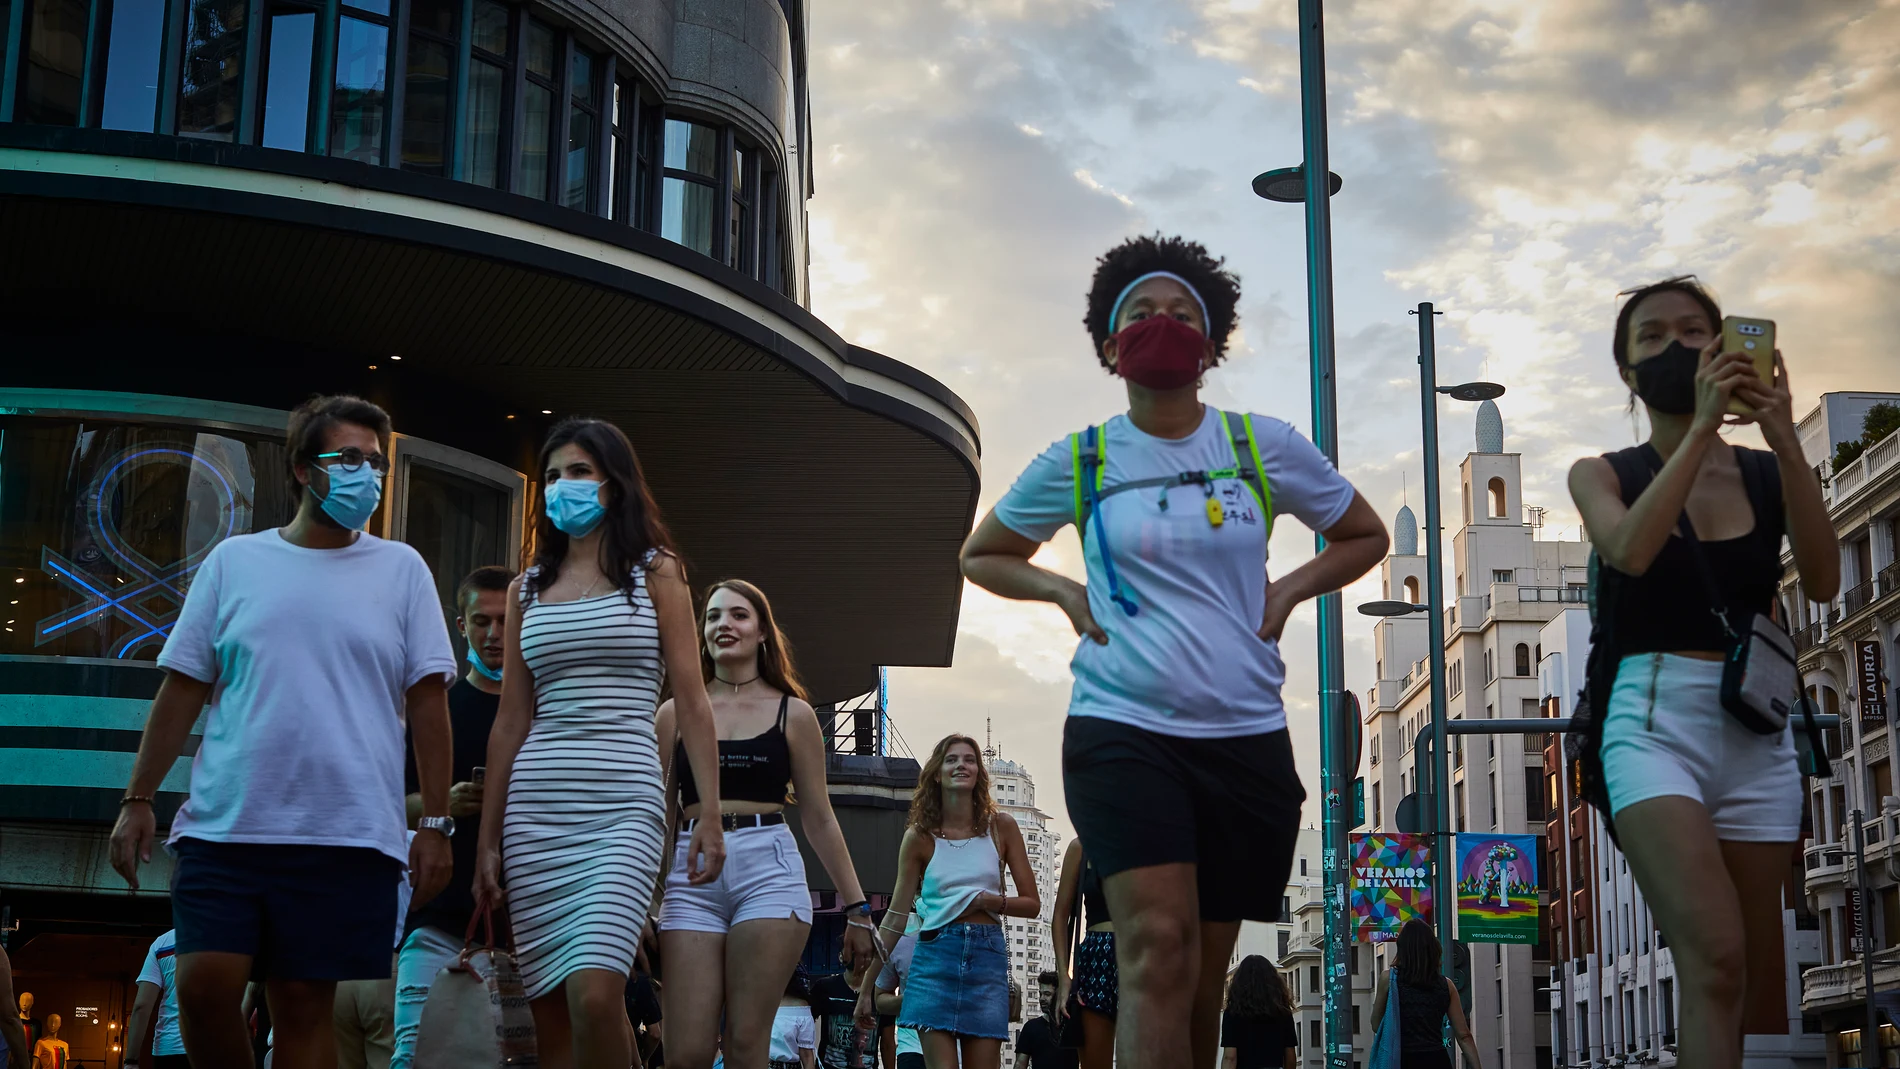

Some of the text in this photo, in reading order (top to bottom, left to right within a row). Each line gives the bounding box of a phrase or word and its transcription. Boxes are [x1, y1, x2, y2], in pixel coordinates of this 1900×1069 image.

[1863, 644, 1878, 702] LAURIA
[1323, 857, 1335, 870] 54
[1355, 867, 1426, 879] VERANOS
